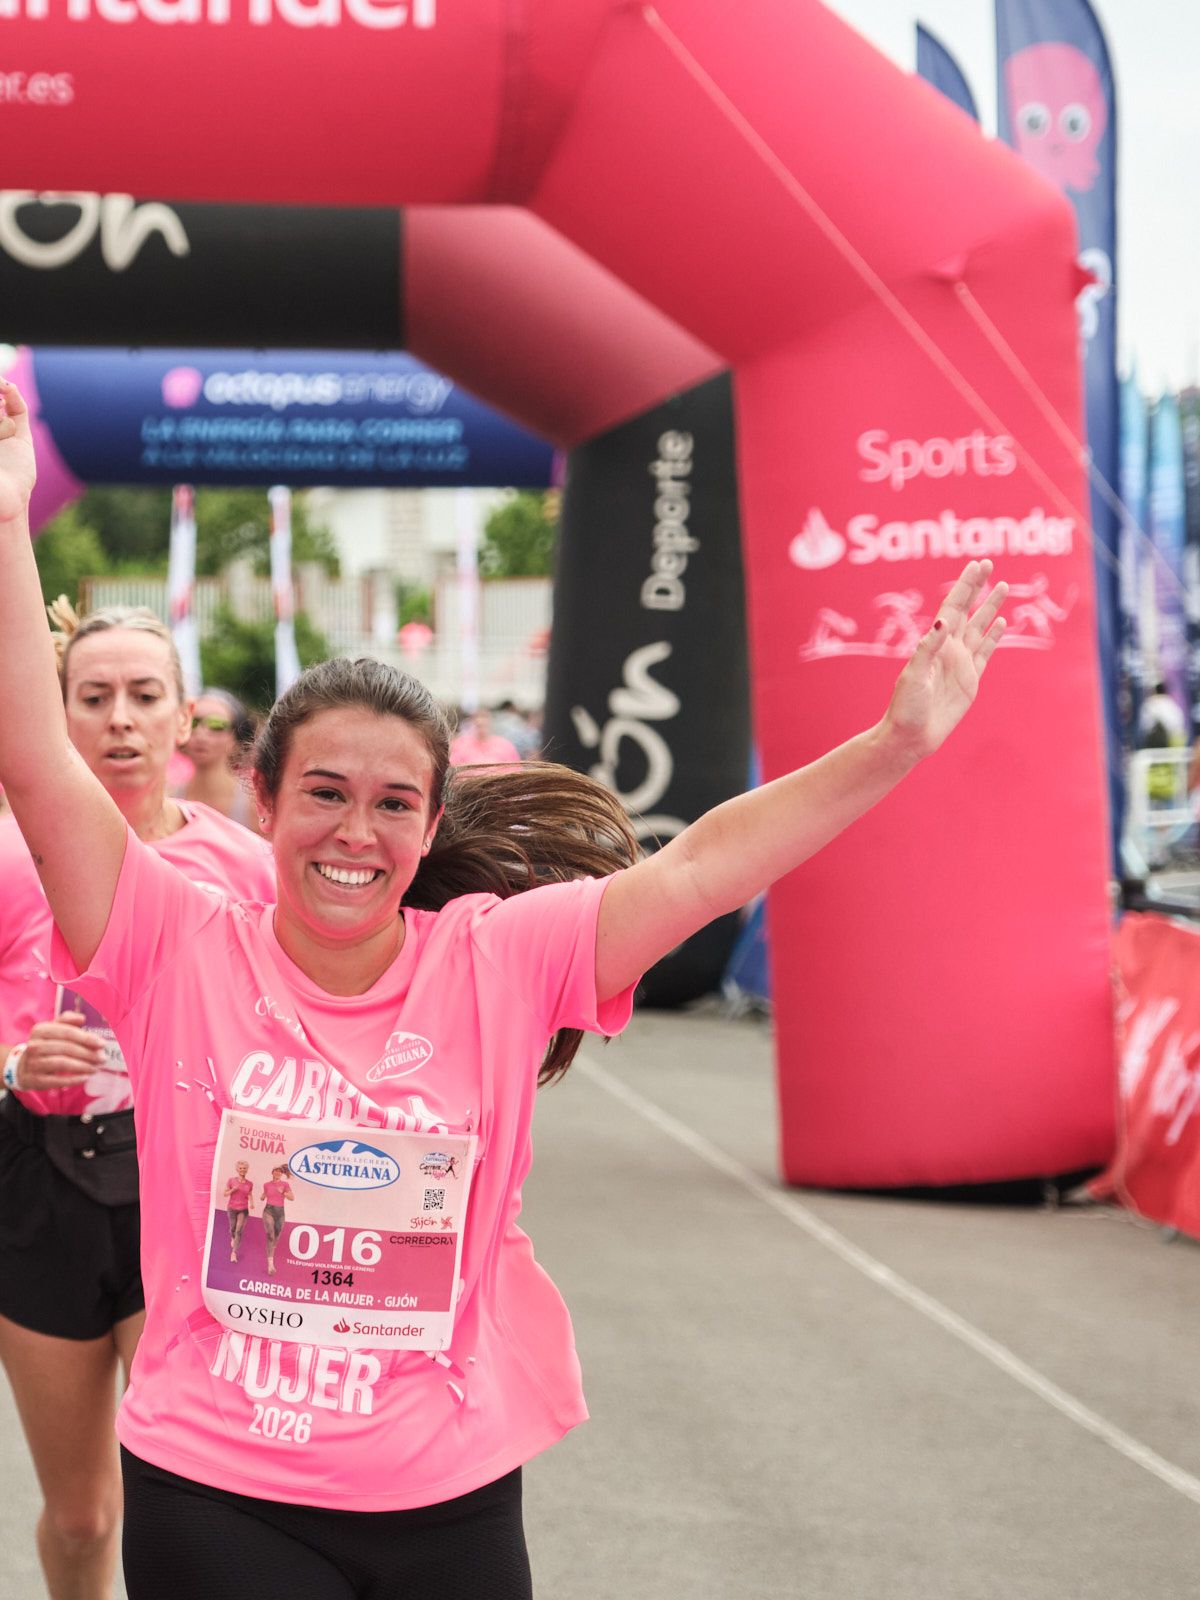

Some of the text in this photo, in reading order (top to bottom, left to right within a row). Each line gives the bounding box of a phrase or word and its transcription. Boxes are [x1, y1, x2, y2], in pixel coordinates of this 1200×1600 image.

[855, 428, 1018, 492] Sports
[640, 428, 700, 612] Deporte
[846, 507, 1076, 565] Santander
[239, 1136, 286, 1155] SUMA
[240, 1127, 287, 1142] TU DORSAL
[297, 1154, 392, 1181] ASTURIANA
[288, 1225, 382, 1266] 016
[389, 1235, 453, 1245] CORREDORA
[311, 1269, 354, 1287] 1364
[239, 1279, 292, 1298] CARRERA
[296, 1288, 311, 1300] DE
[315, 1290, 330, 1302] LA
[333, 1292, 374, 1306] MUJER
[385, 1293, 418, 1308] GIJÓN
[227, 1303, 304, 1329] OYSHO
[353, 1322, 425, 1337] Santander
[248, 1403, 313, 1444] 2026
